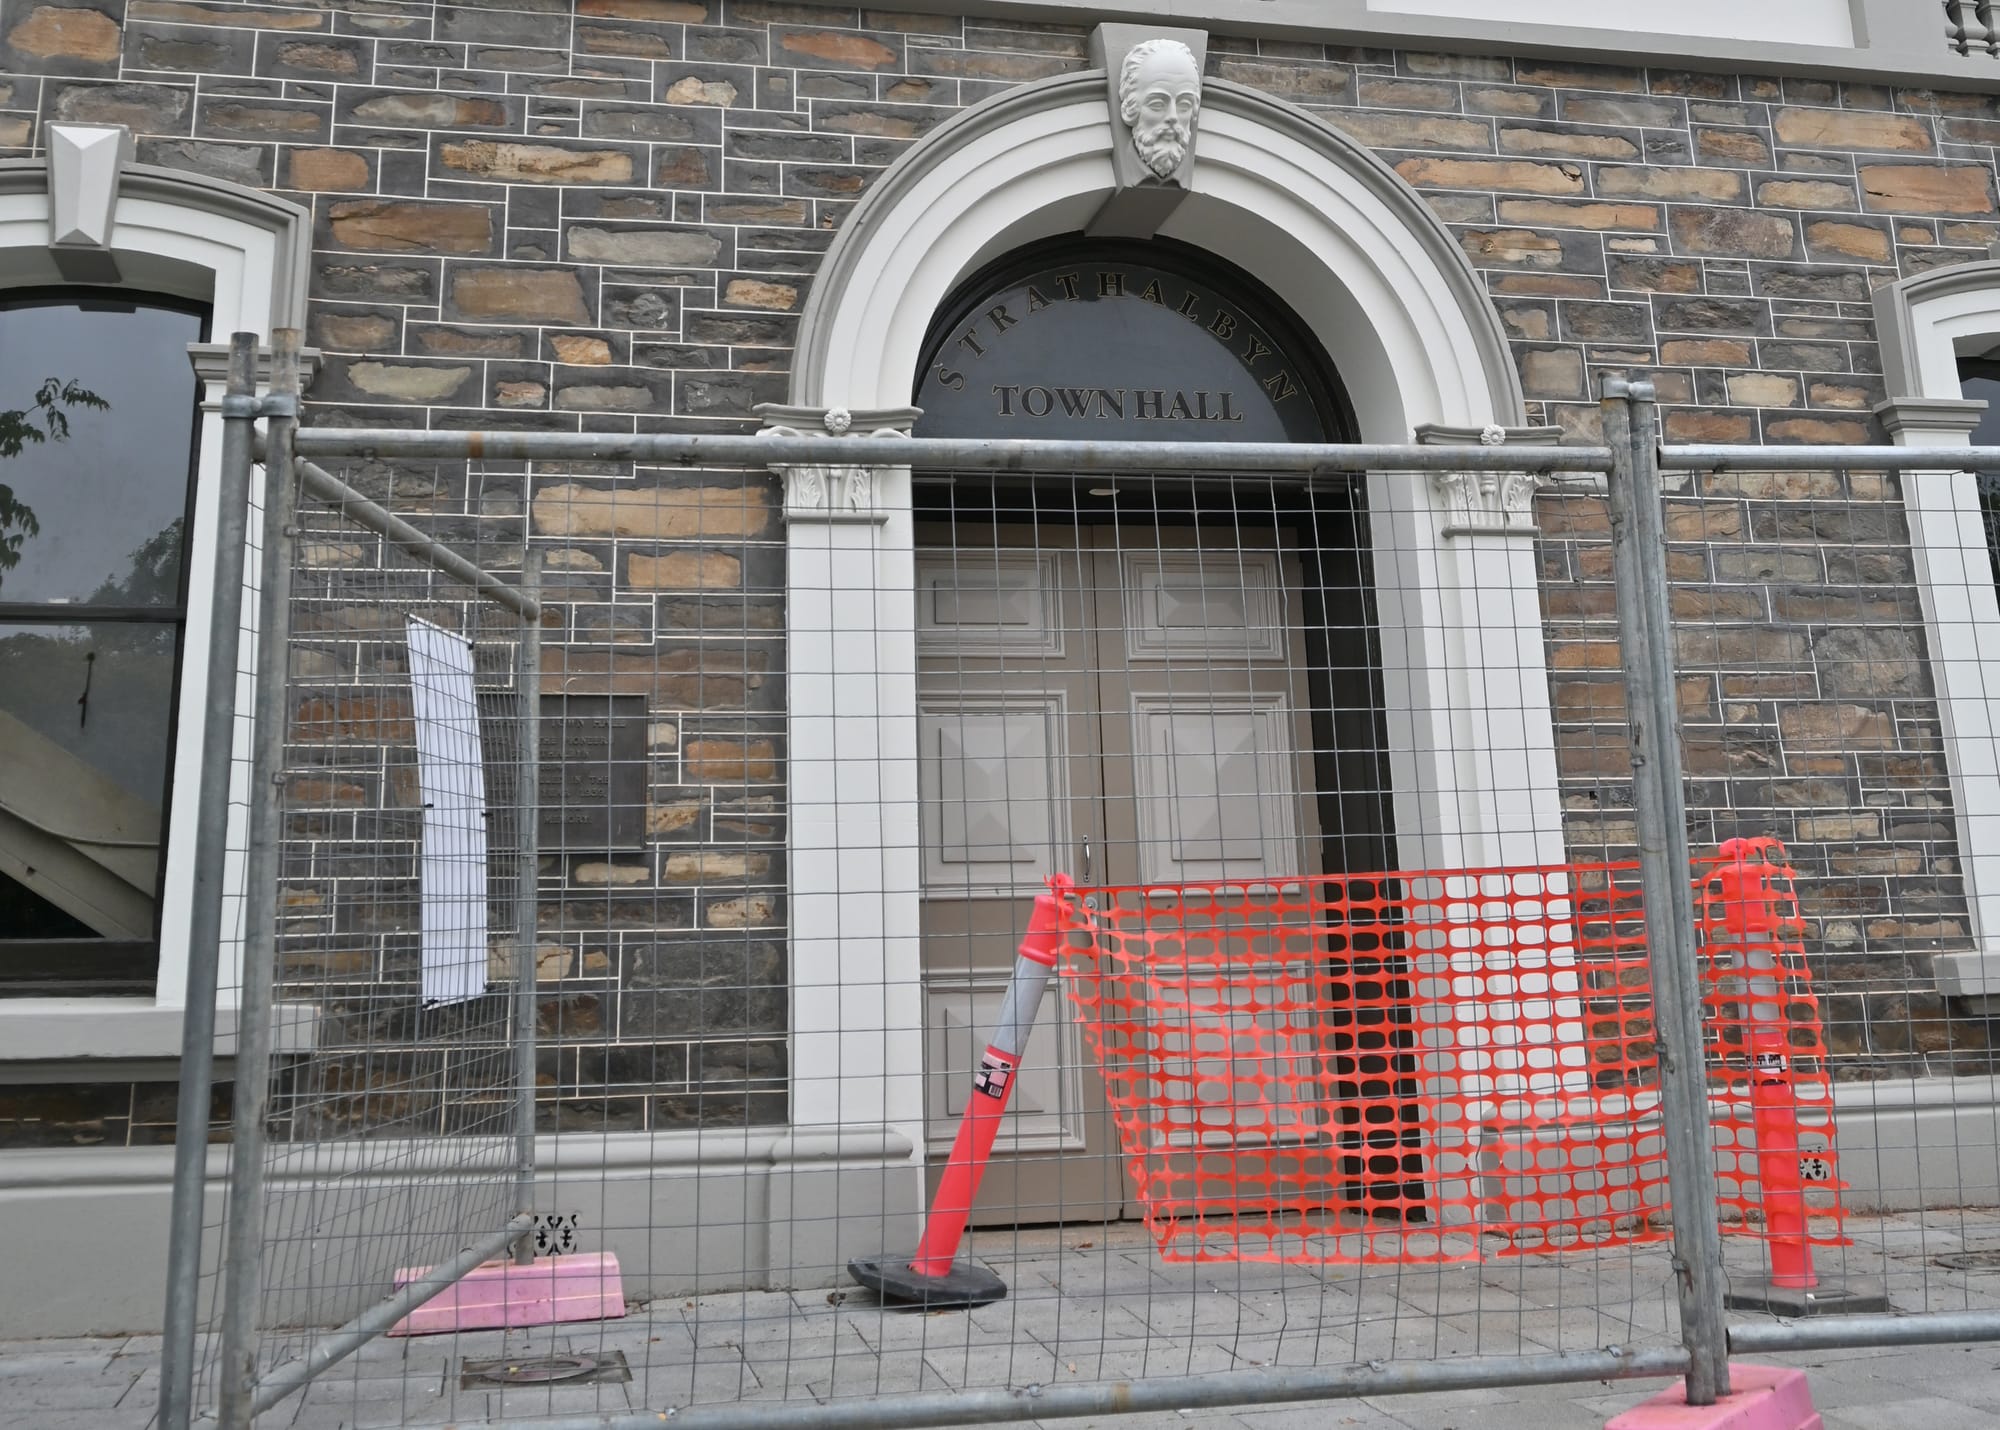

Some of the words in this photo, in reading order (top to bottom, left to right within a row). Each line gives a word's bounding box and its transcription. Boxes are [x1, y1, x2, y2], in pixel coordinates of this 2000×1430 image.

[938, 271, 1298, 402] STRATHALBYN
[992, 384, 1126, 420] TOWN
[1133, 389, 1244, 422] HALL
